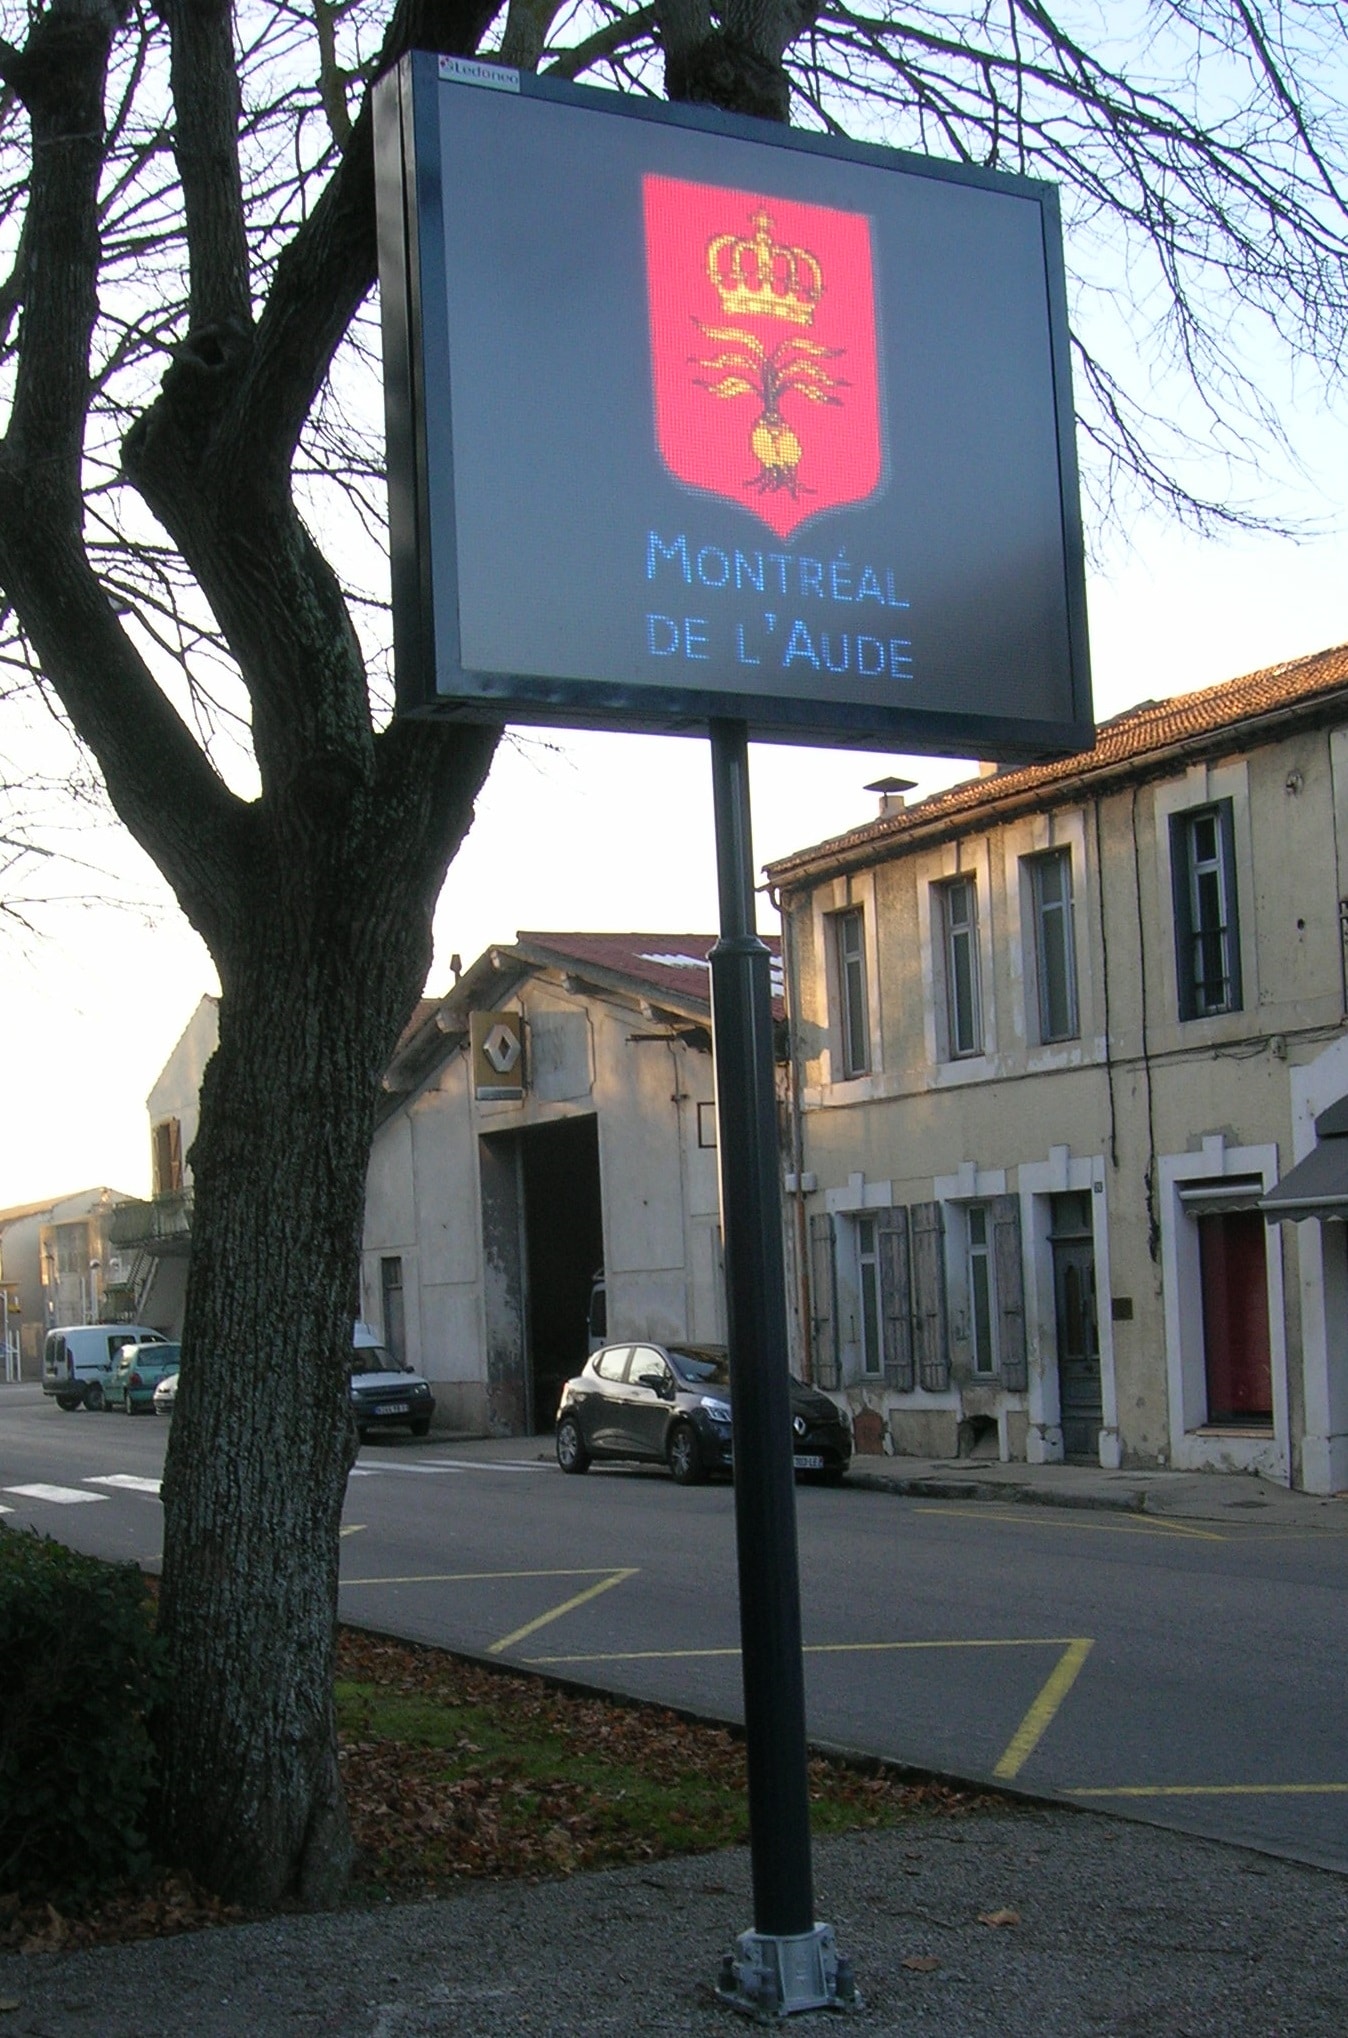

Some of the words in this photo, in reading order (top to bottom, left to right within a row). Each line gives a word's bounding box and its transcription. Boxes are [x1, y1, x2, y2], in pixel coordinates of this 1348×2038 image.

[647, 530, 910, 608] MONTRÉAL
[646, 614, 710, 660] DE
[736, 612, 914, 679] L'AUDE
